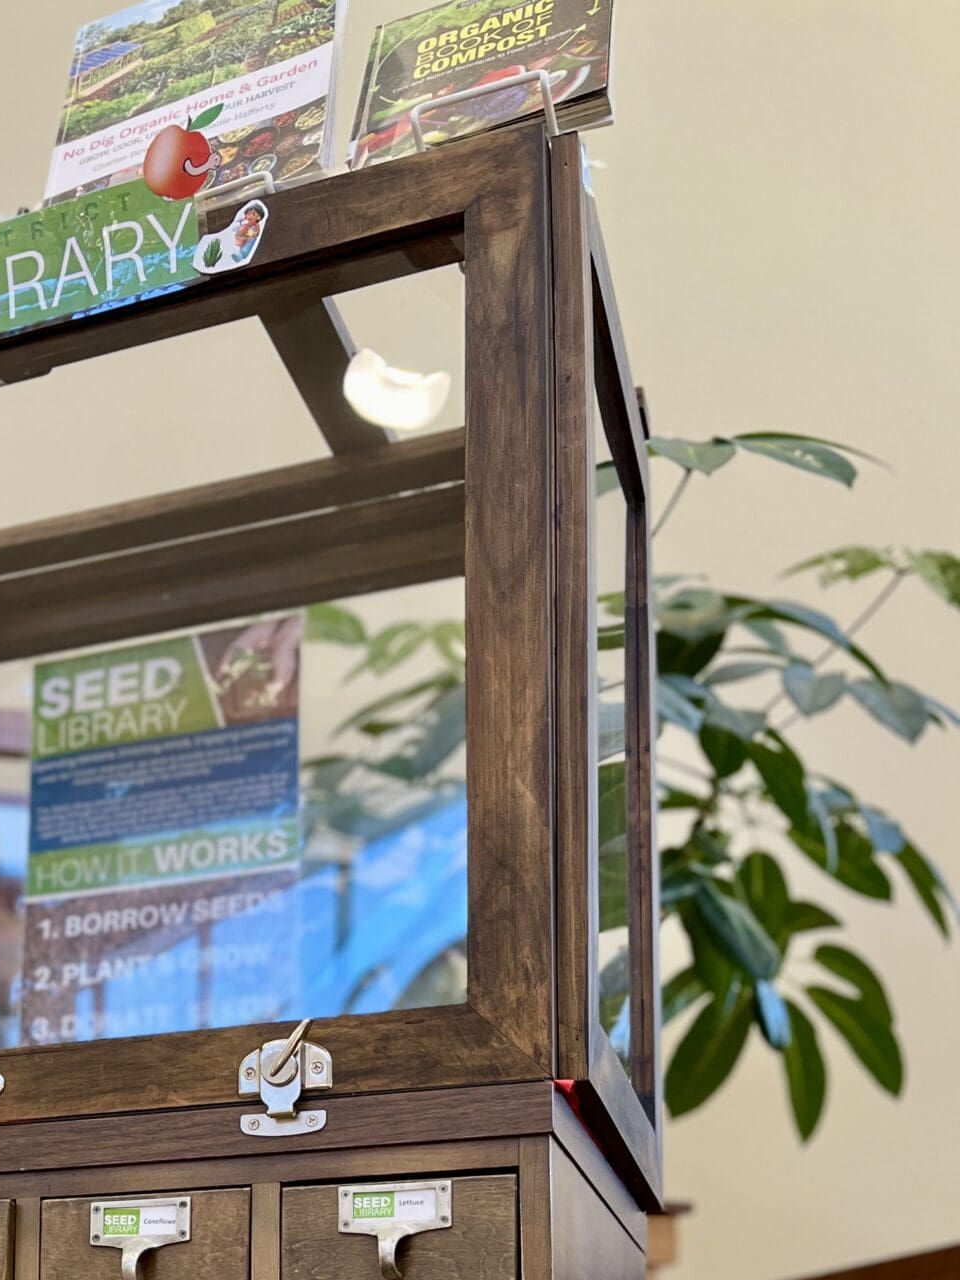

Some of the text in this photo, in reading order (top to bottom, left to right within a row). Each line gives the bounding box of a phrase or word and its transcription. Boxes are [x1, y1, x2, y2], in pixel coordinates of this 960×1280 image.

[413, 22, 552, 79] COMPOST
[416, 10, 553, 66] BOOK OF
[417, 0, 554, 53] ORGANIC
[63, 147, 85, 161] No
[92, 136, 114, 154] Dig
[120, 111, 181, 140] Organic
[186, 89, 234, 115] Home
[239, 82, 252, 94] &
[257, 59, 318, 87] Garden
[246, 81, 296, 103] HARVEST
[39, 656, 182, 720] SEED
[38, 701, 188, 755] LIBRARY
[35, 829, 289, 891] HOW IT WORKS
[38, 919, 59, 940] 1.
[65, 900, 188, 937] BORROW
[33, 967, 57, 991] 2.
[62, 956, 154, 986] PLANT
[105, 1215, 137, 1225] SEED
[354, 1197, 391, 1208] SEED
[354, 1208, 392, 1217] LIBRARY
